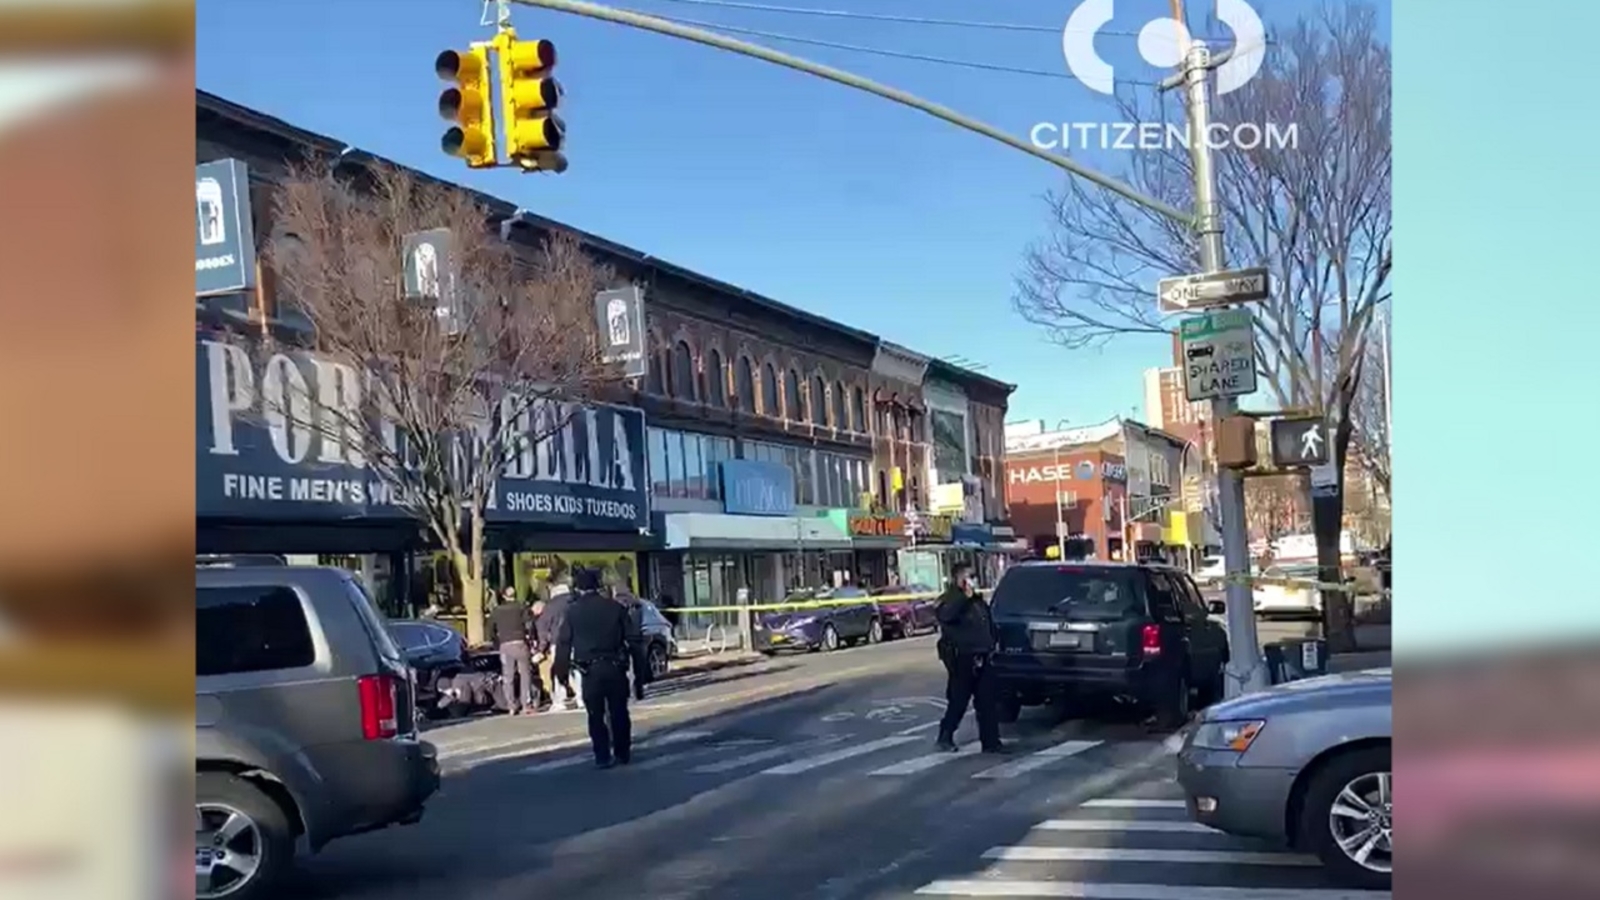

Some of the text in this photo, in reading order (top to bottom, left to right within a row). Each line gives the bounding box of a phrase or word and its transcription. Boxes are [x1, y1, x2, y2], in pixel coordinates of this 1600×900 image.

[1171, 285, 1203, 301] ONE
[1190, 358, 1249, 378] SHARED
[1200, 375, 1239, 392] LANE
[1010, 463, 1072, 485] HASE
[223, 473, 283, 499] FINE
[290, 477, 365, 504] MEN'S
[506, 491, 552, 512] SHOES
[554, 495, 584, 514] KIDS
[586, 496, 637, 519] TUXEDOS
